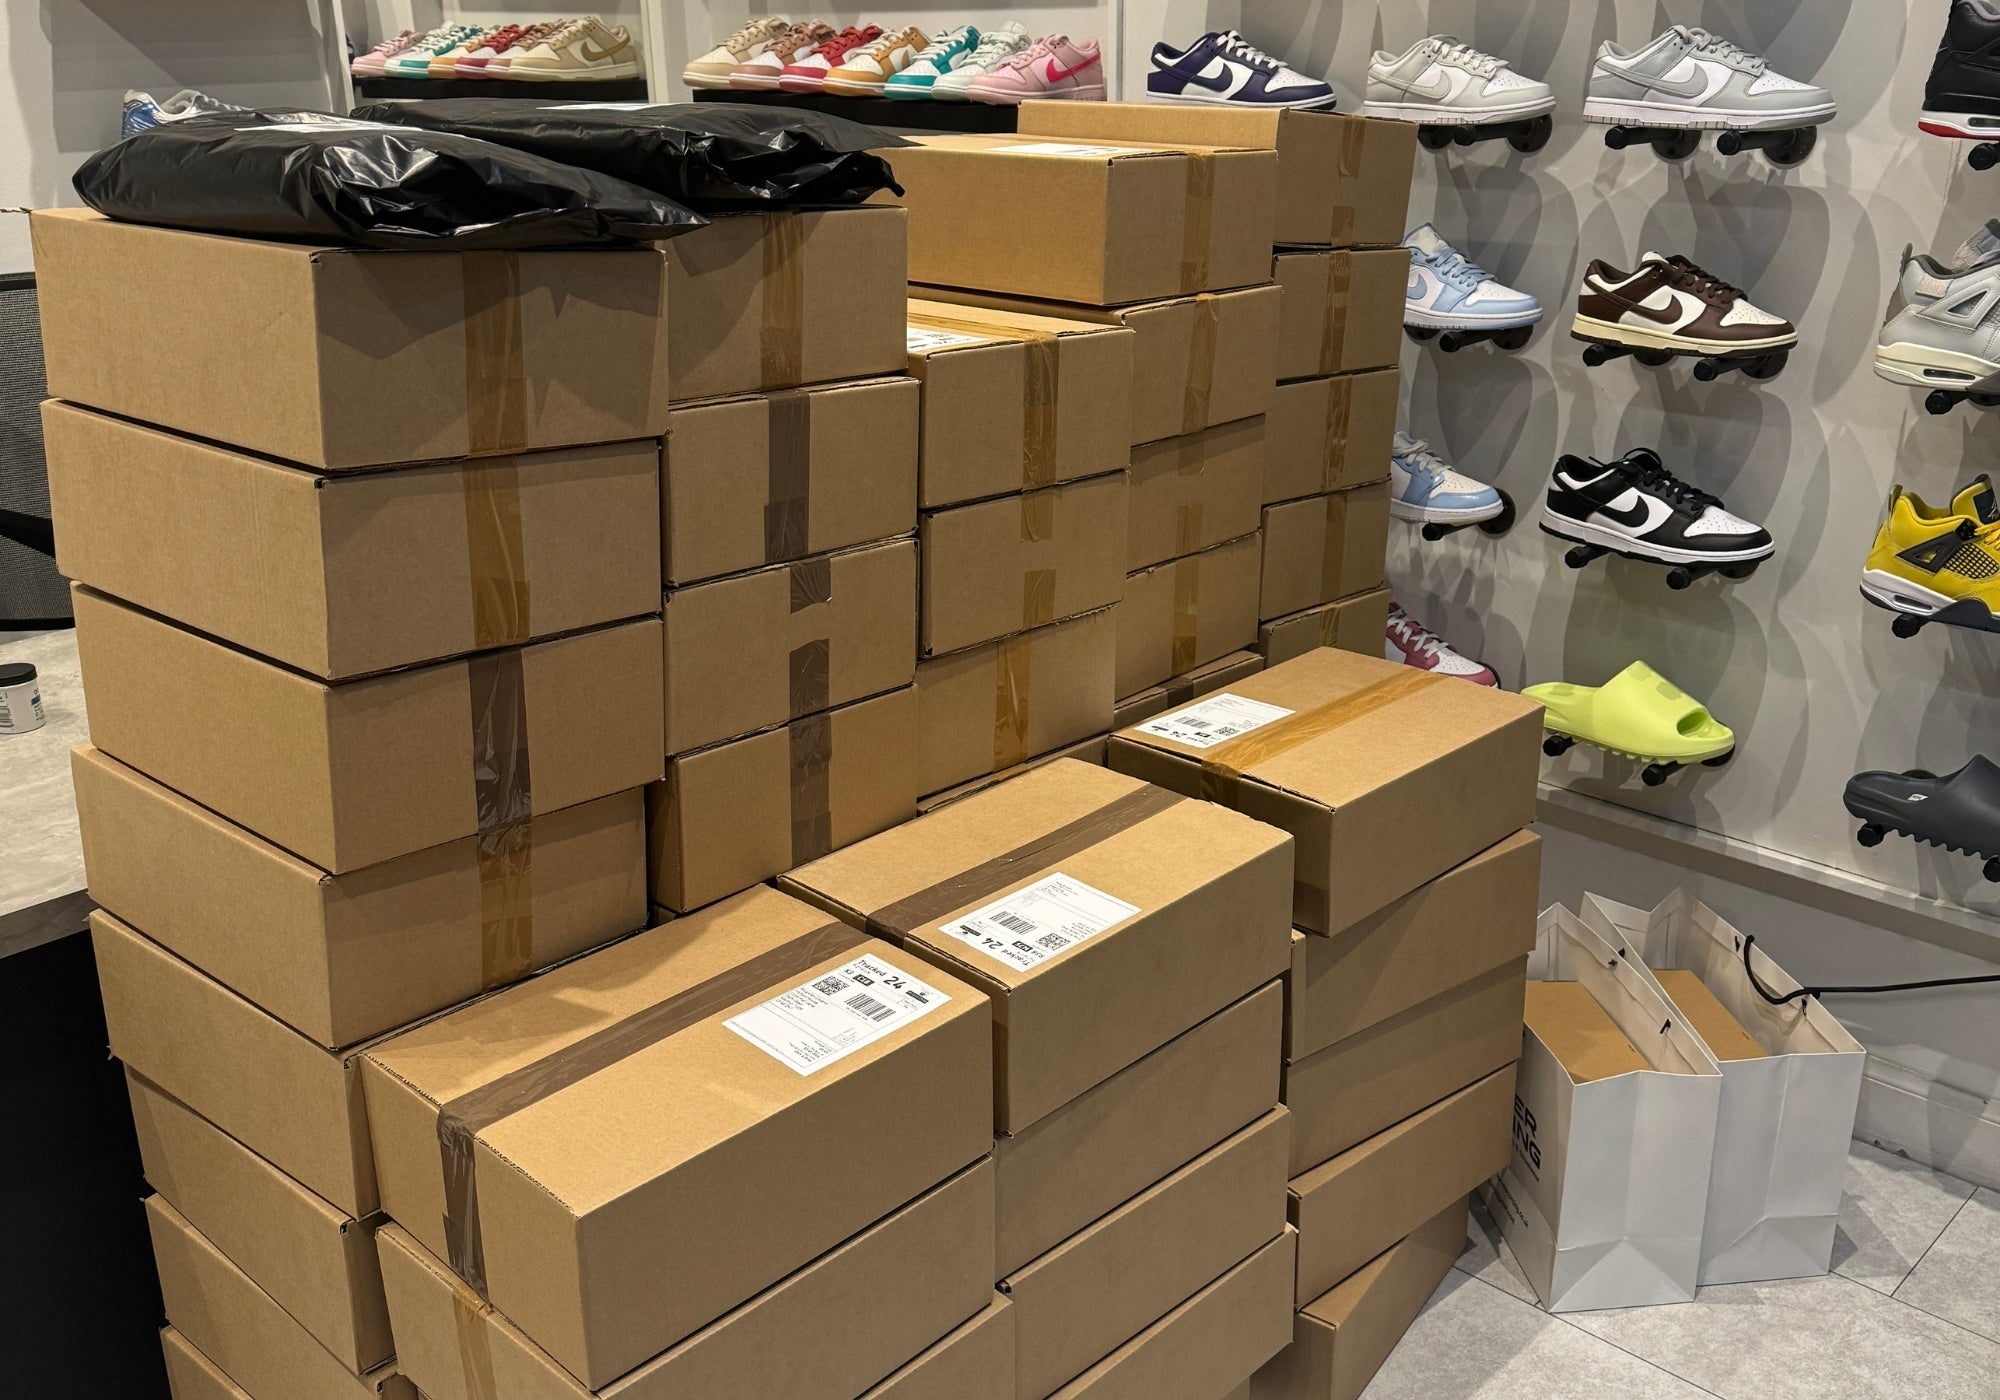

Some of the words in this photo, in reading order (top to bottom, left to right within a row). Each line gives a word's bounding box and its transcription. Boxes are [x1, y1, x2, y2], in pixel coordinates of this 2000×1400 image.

[981, 937, 1004, 950] 24
[1001, 949, 1030, 966] Tracked
[858, 959, 888, 977] Tracked
[882, 975, 907, 989] 24
[1514, 1092, 1537, 1138] ER
[1512, 1115, 1542, 1170] ING
